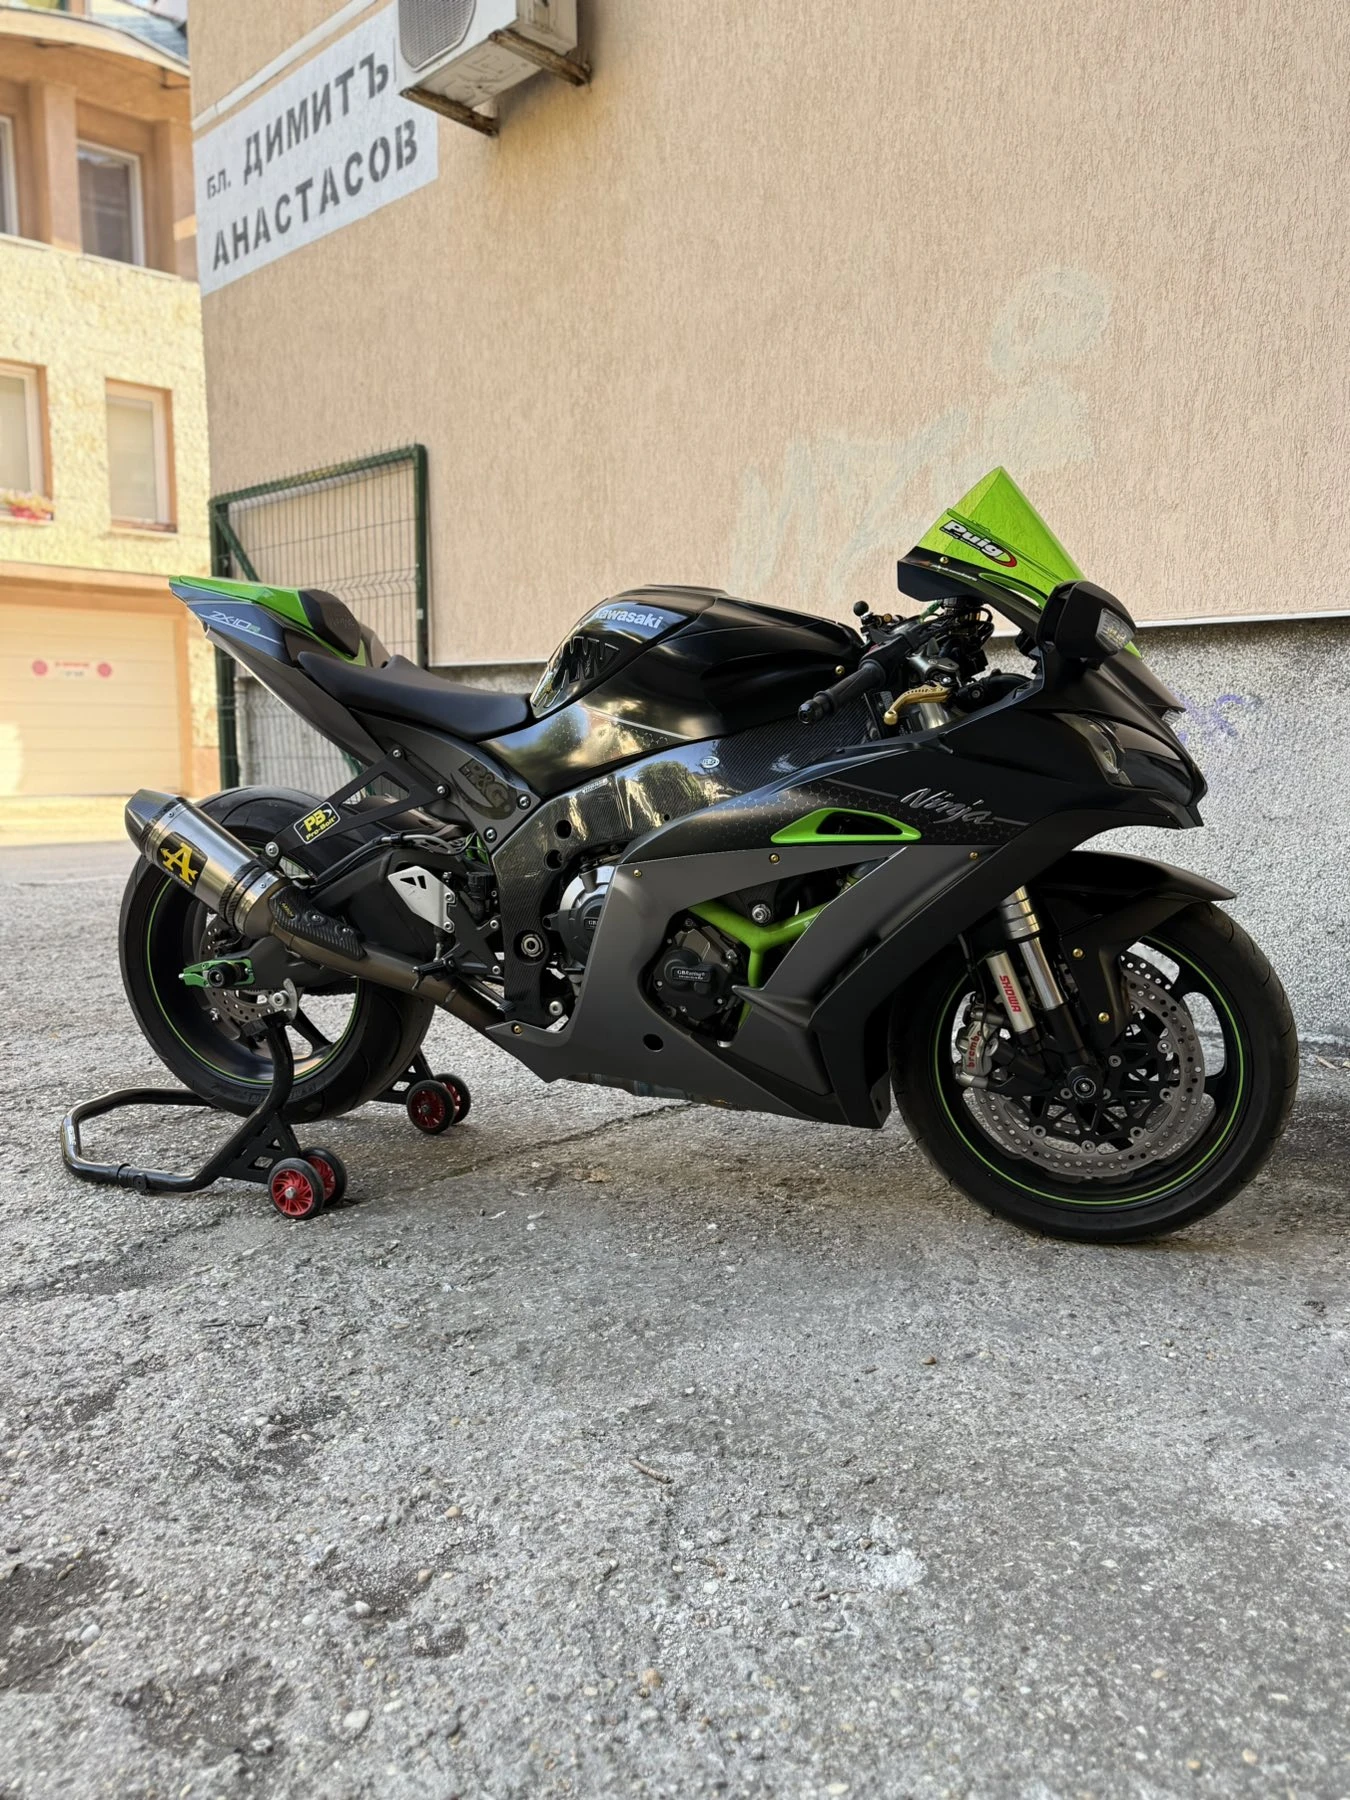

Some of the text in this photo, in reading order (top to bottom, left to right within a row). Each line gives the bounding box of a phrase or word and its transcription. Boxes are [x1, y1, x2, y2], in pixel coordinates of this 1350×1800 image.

[243, 37, 396, 186] ДИМИТЪ
[212, 119, 417, 271] АНАСТАСОВ
[942, 519, 1004, 558] Puig
[303, 809, 326, 832] PB
[900, 787, 994, 824] Ninja
[999, 975, 1022, 1013] SHOWA
